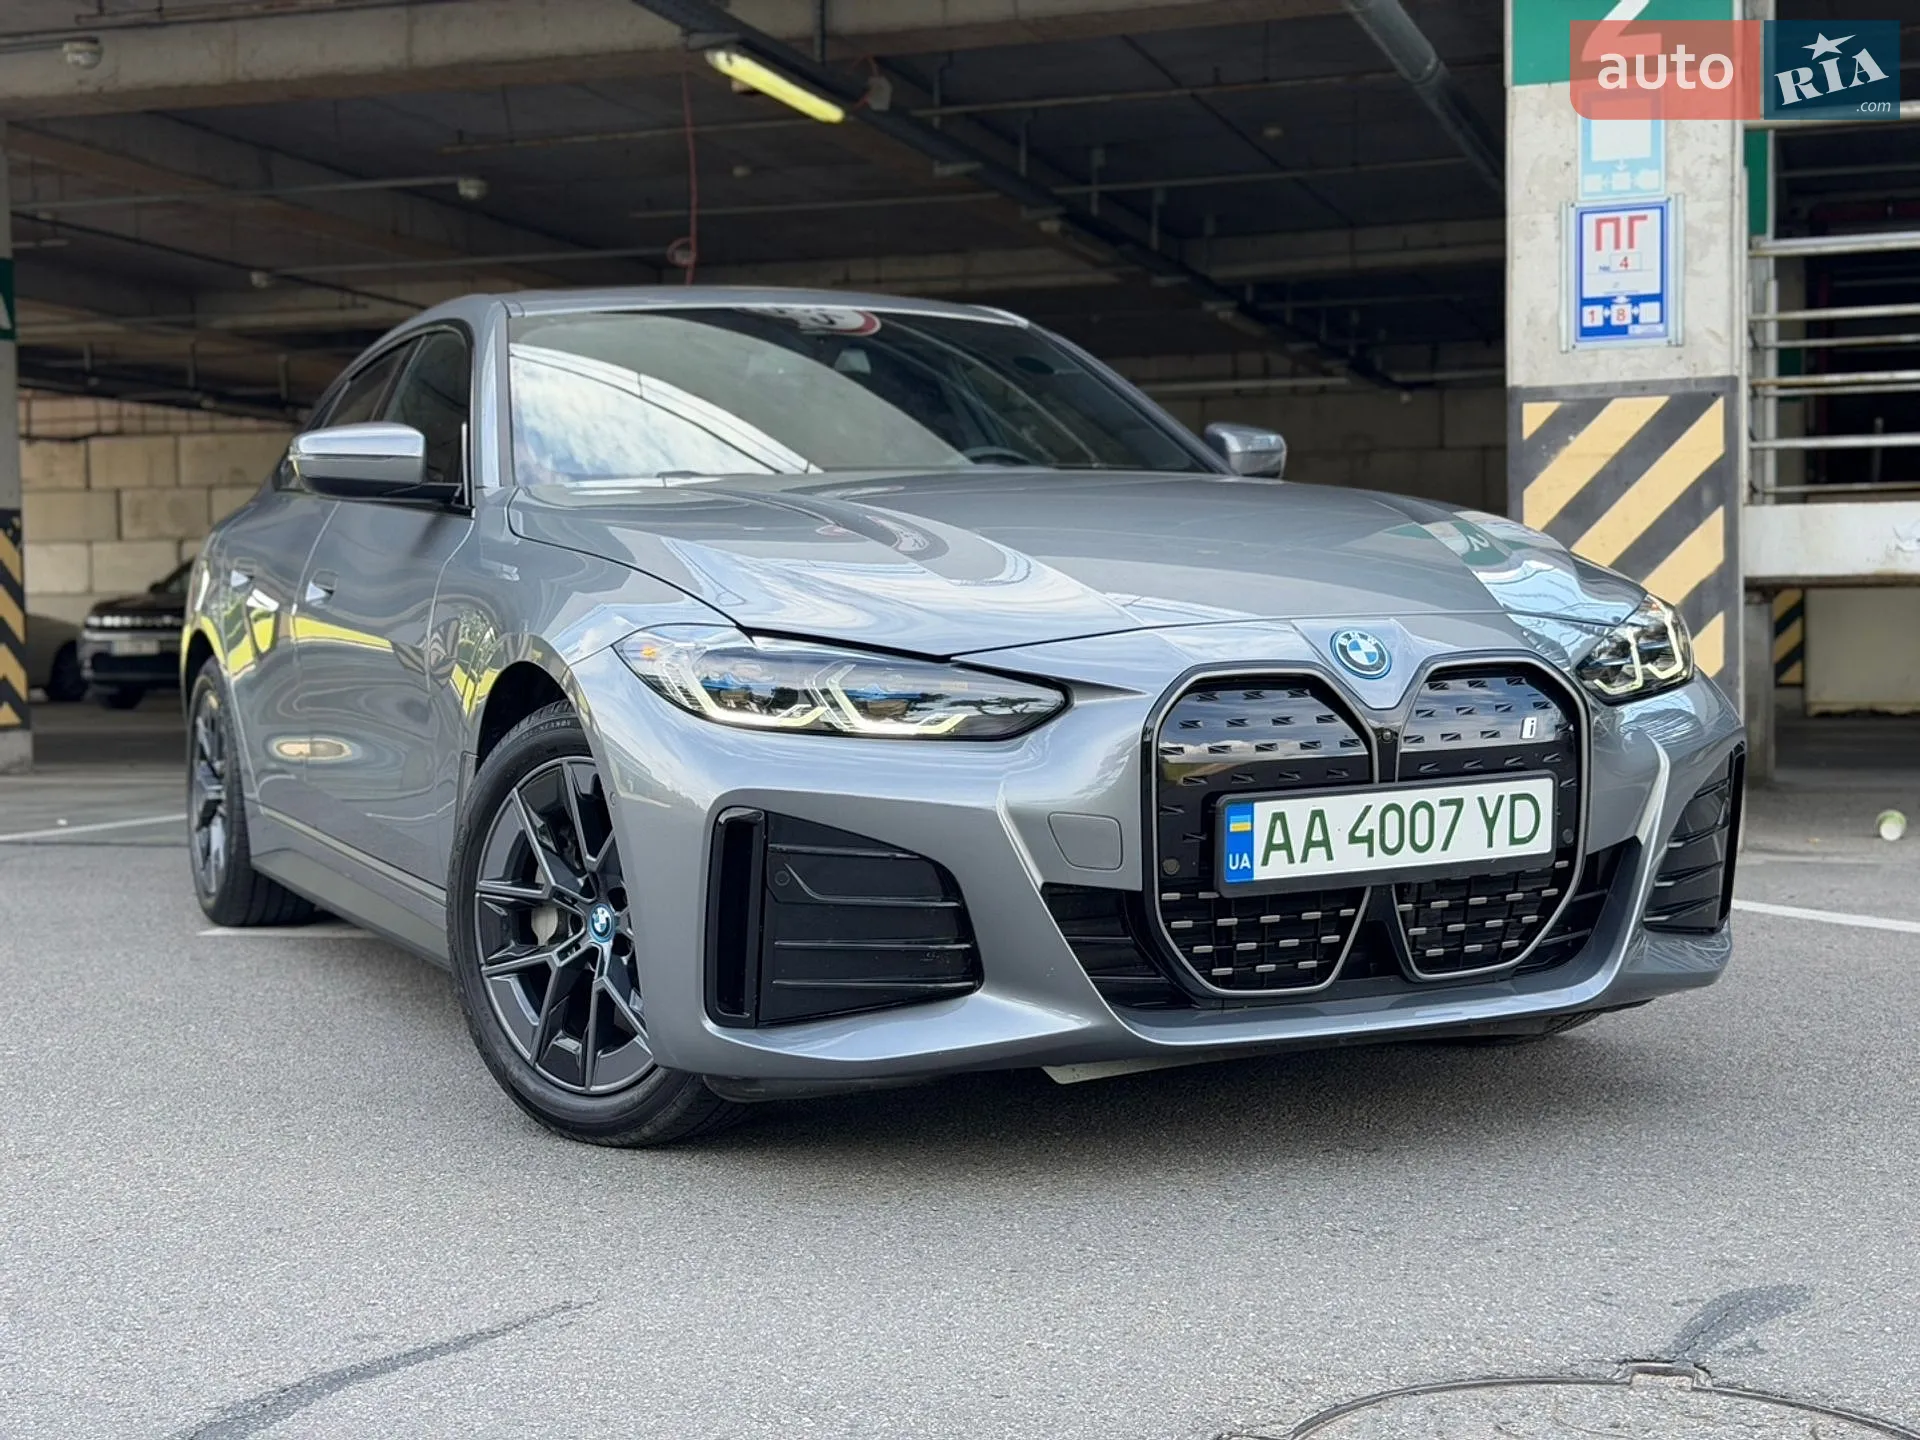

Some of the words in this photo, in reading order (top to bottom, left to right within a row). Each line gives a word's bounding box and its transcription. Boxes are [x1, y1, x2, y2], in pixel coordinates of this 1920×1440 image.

[1595, 214, 1648, 252] ПГ
[1619, 256, 1629, 270] 4
[1338, 631, 1377, 646] BMW
[1260, 808, 1334, 867] AA
[1347, 797, 1464, 858] 4007
[1477, 792, 1541, 849] YD
[1228, 852, 1251, 870] UA
